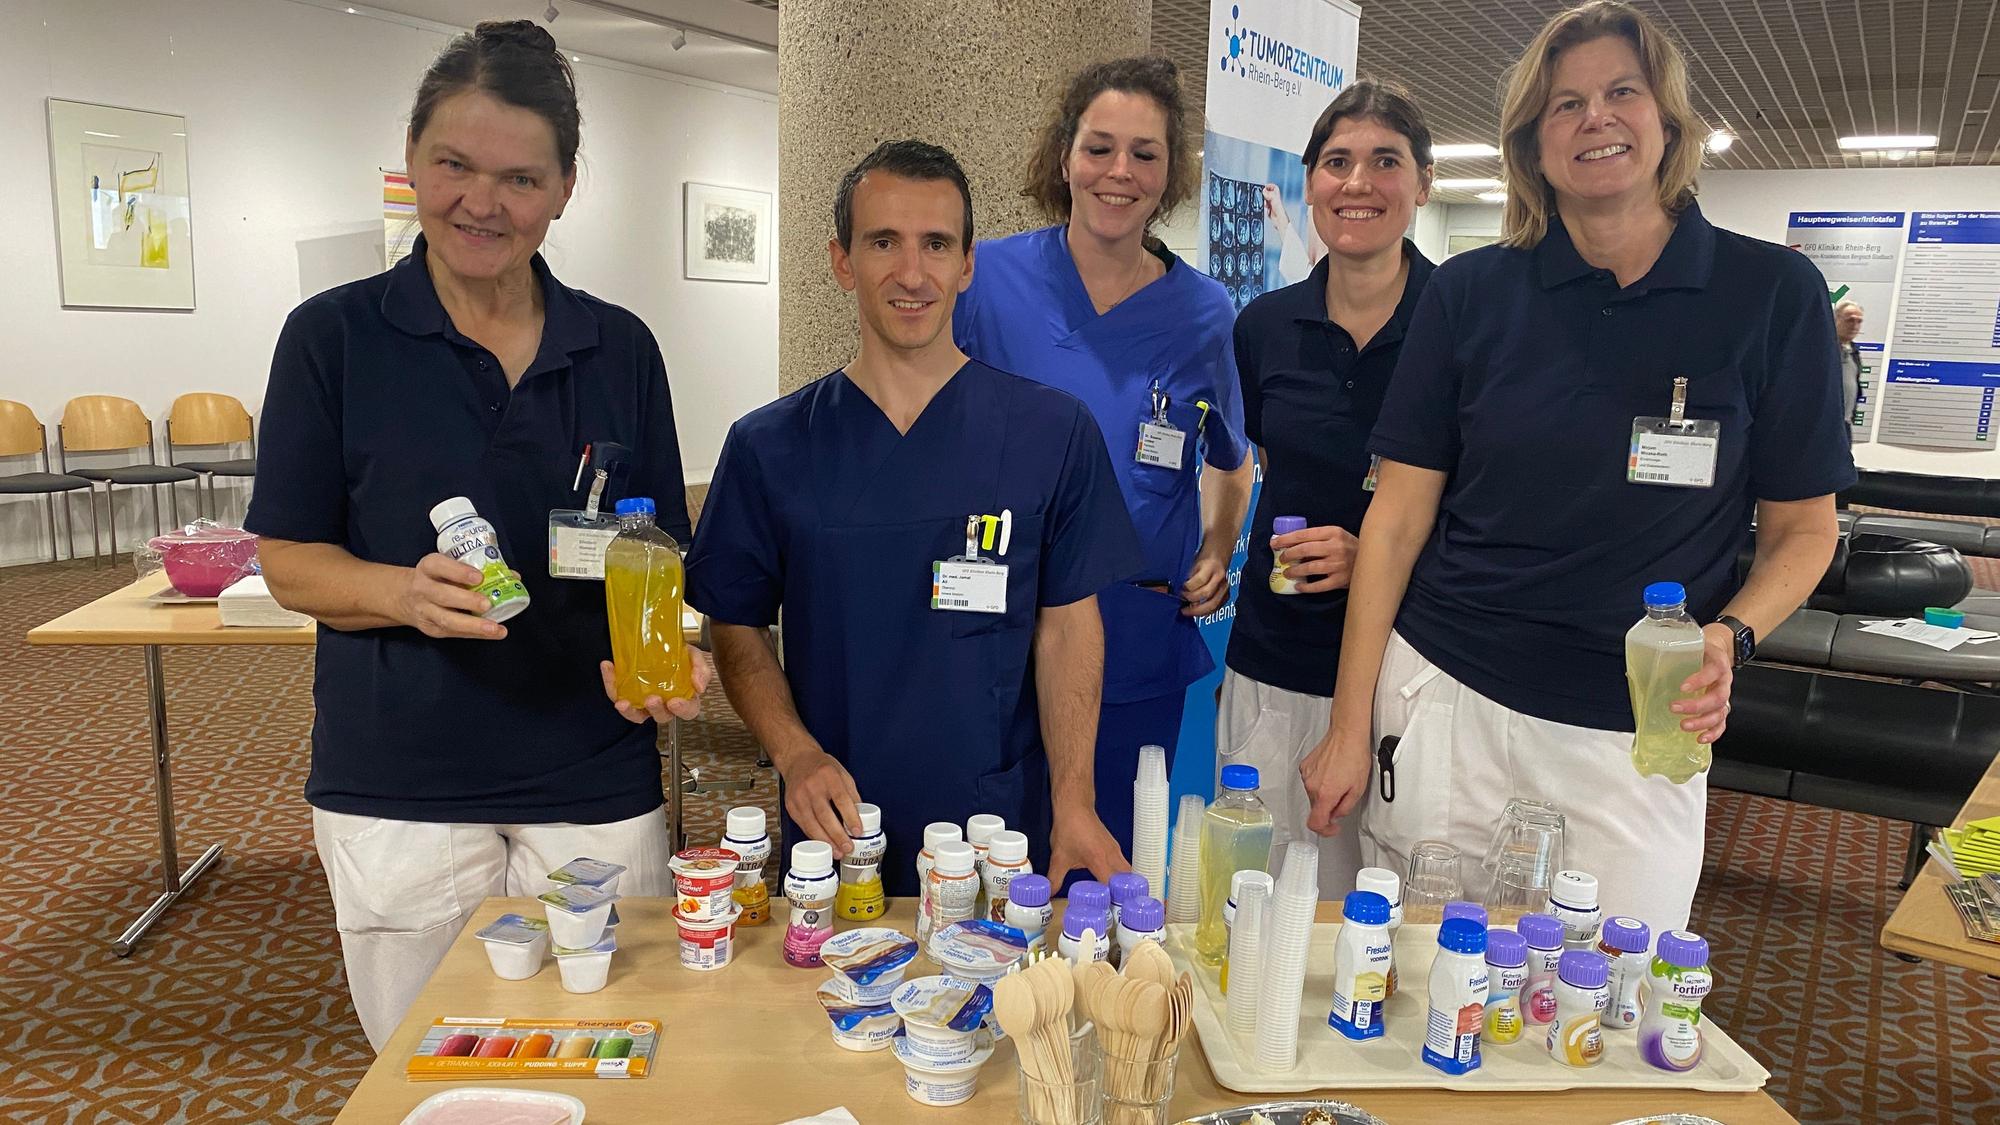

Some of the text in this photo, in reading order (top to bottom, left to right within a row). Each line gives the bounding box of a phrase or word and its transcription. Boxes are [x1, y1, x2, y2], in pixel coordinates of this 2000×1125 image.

[1249, 30, 1343, 91] TUMORZENTRUM
[1248, 63, 1290, 97] Rhein-Berg
[1797, 215, 1896, 224] Hauptwegweiser/Infotafel
[1804, 243, 1817, 251] GFO
[1844, 243, 1881, 253] Rhein-Berg
[451, 537, 483, 559] ULTRA
